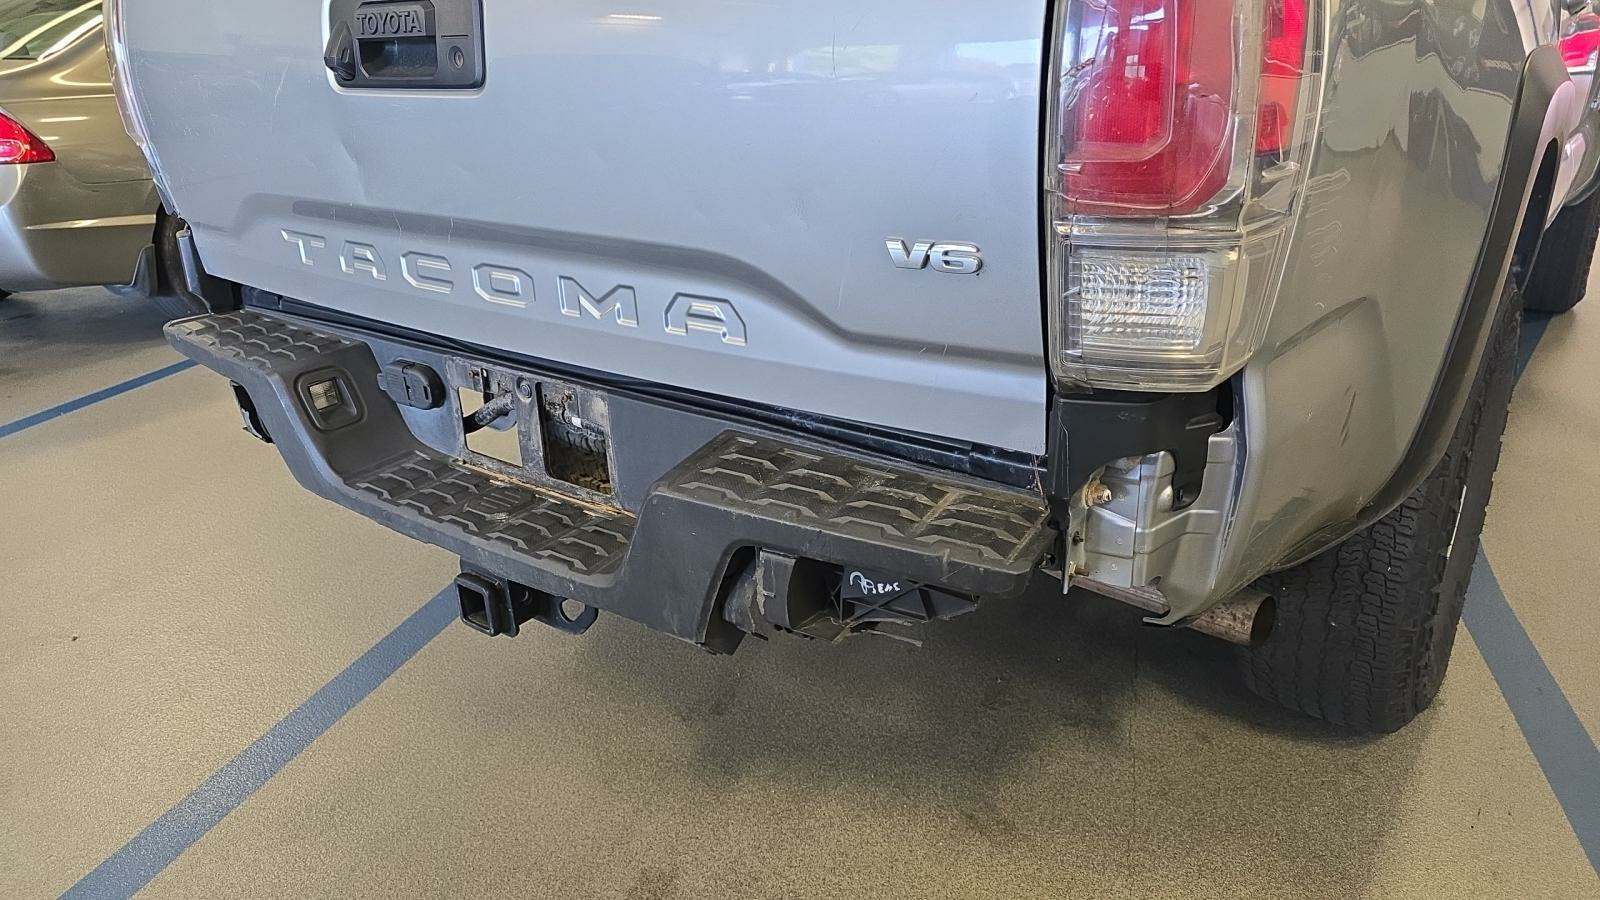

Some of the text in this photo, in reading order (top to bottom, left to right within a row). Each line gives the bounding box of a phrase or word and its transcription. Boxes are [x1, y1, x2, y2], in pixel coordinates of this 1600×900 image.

[355, 10, 423, 36] TOYOTA
[884, 237, 983, 275] V6
[280, 228, 748, 346] TACOMA
